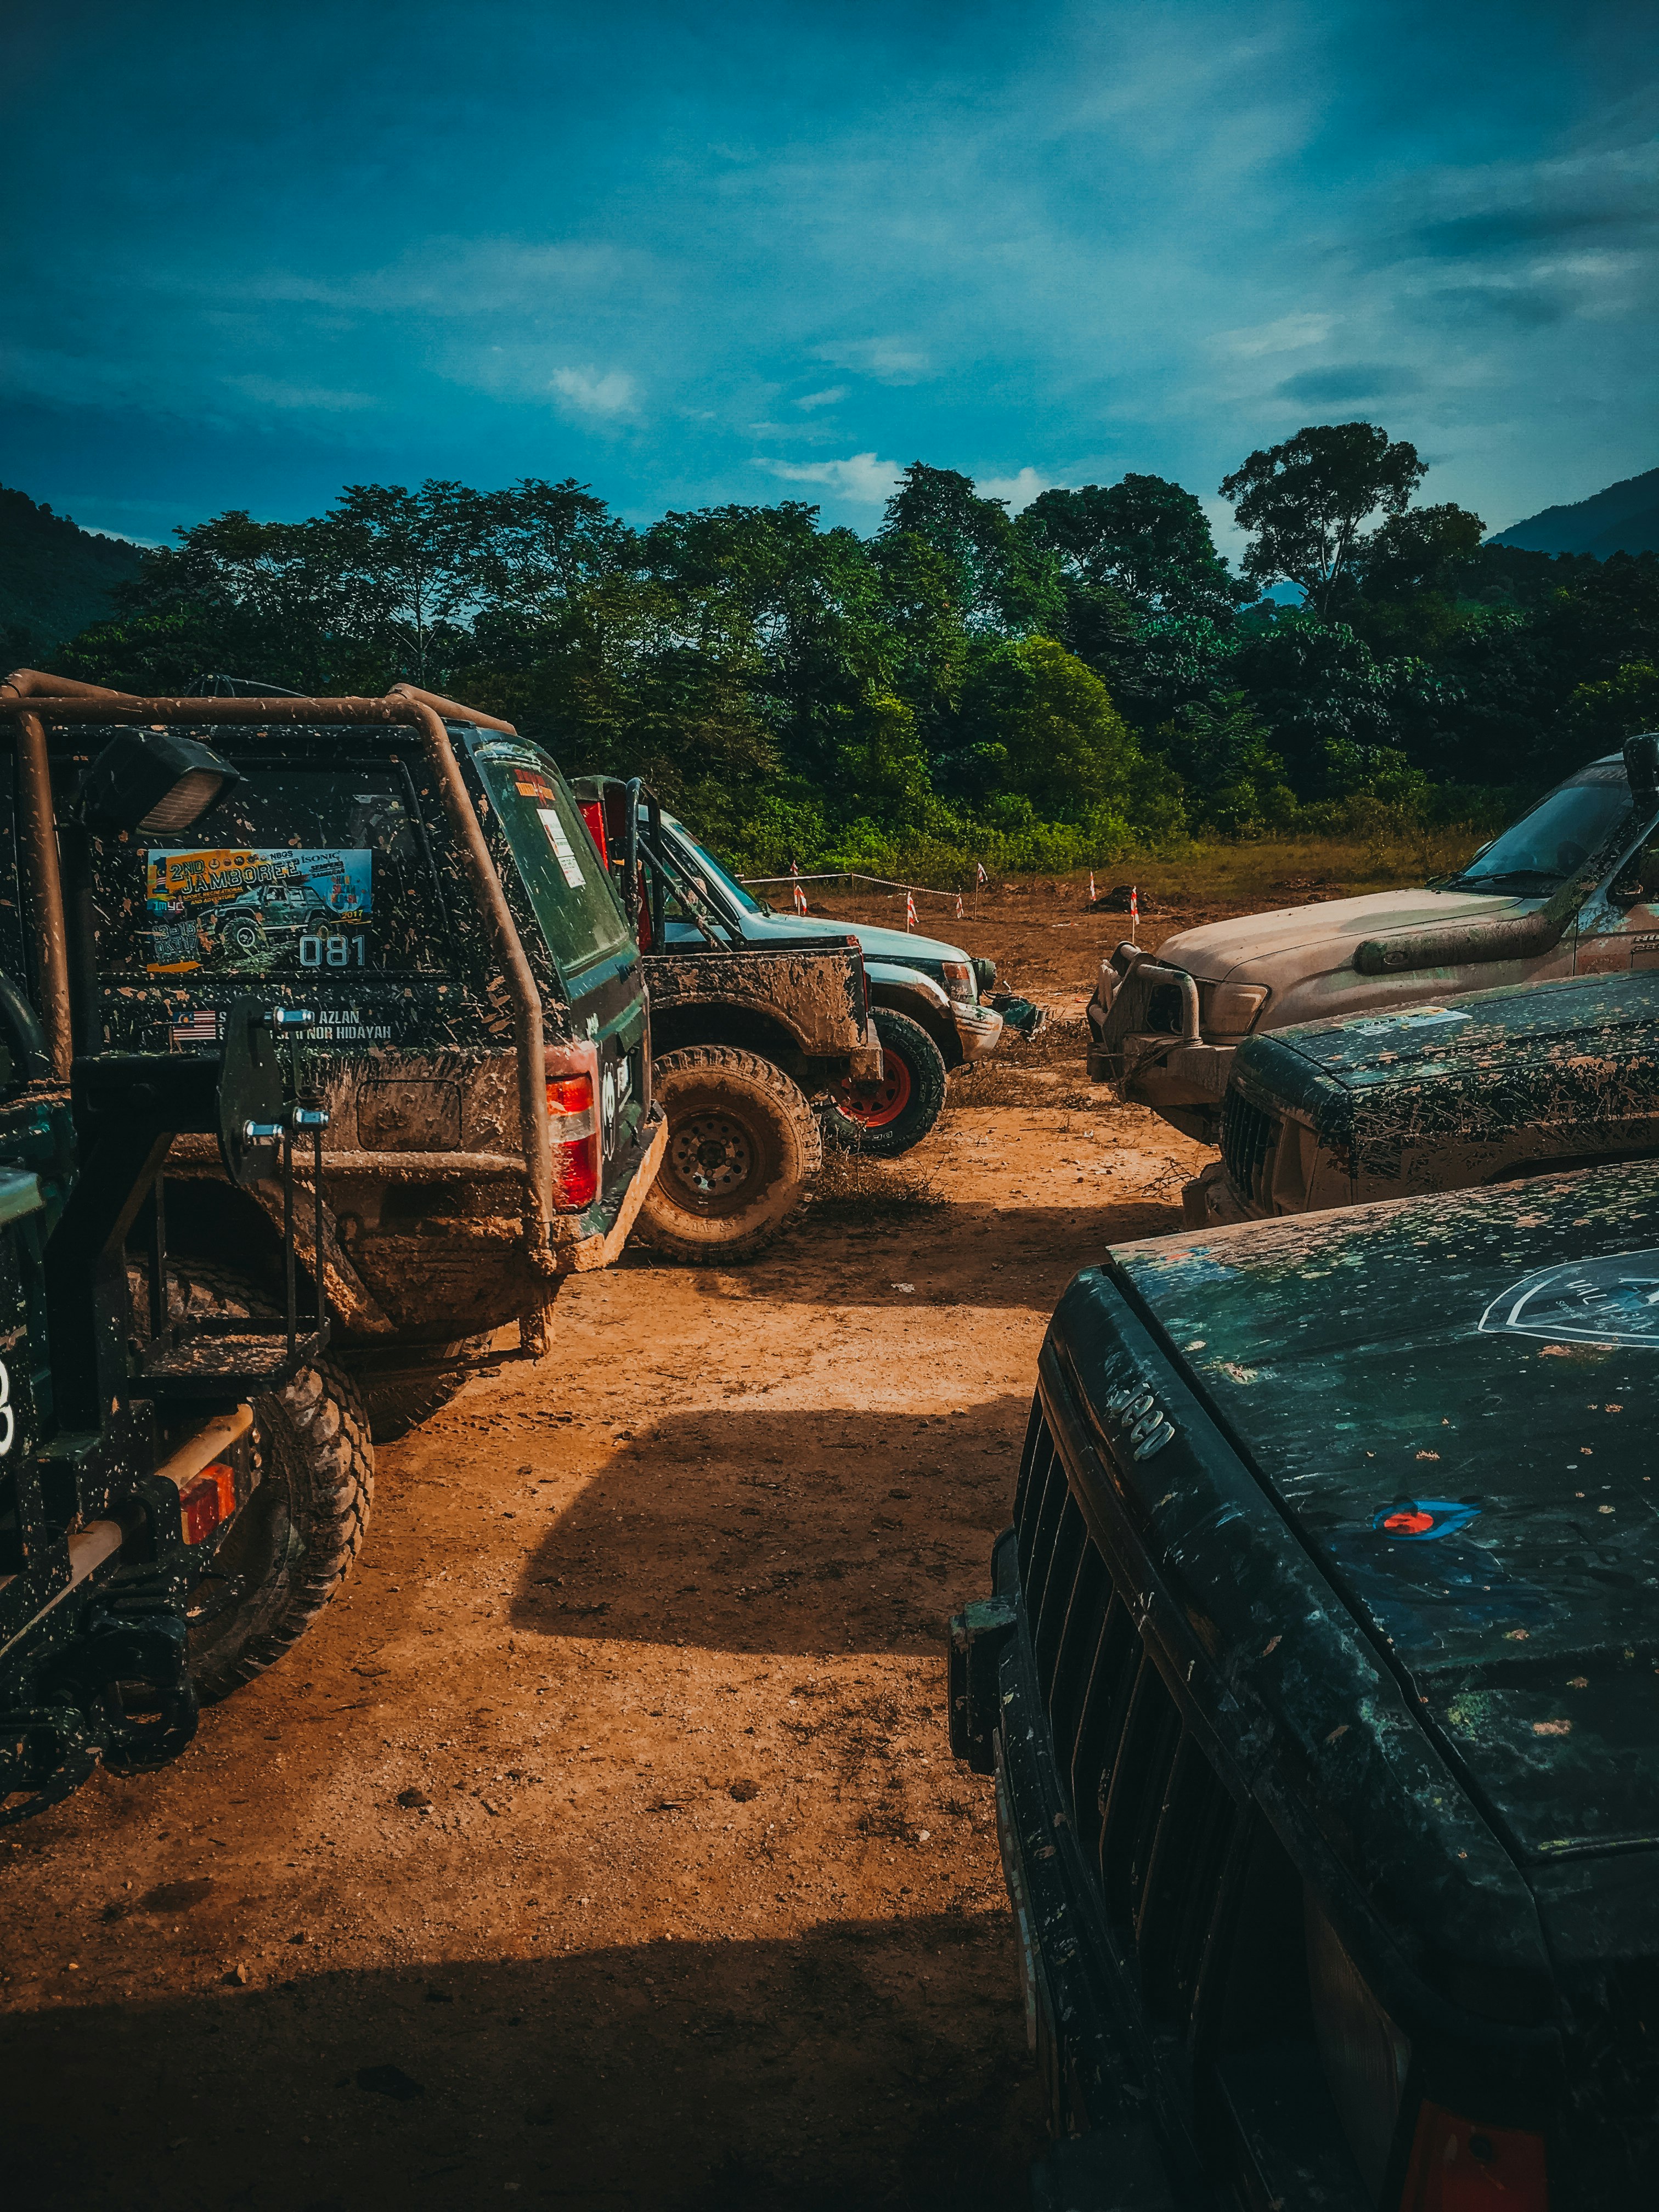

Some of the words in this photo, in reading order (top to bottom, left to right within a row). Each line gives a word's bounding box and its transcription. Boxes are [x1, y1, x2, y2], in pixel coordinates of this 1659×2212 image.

[269, 850, 294, 860] NBGS
[169, 859, 205, 882] 2ND
[181, 857, 302, 894] JAMBOREE
[204, 893, 236, 903] ADVENTURE
[341, 910, 363, 919] 2017
[300, 935, 365, 966] 081
[319, 1011, 359, 1024] AZLAN
[306, 1026, 333, 1040] NOR
[336, 1026, 391, 1040] HIDAYAH
[1110, 1383, 1175, 1462] Jeep
